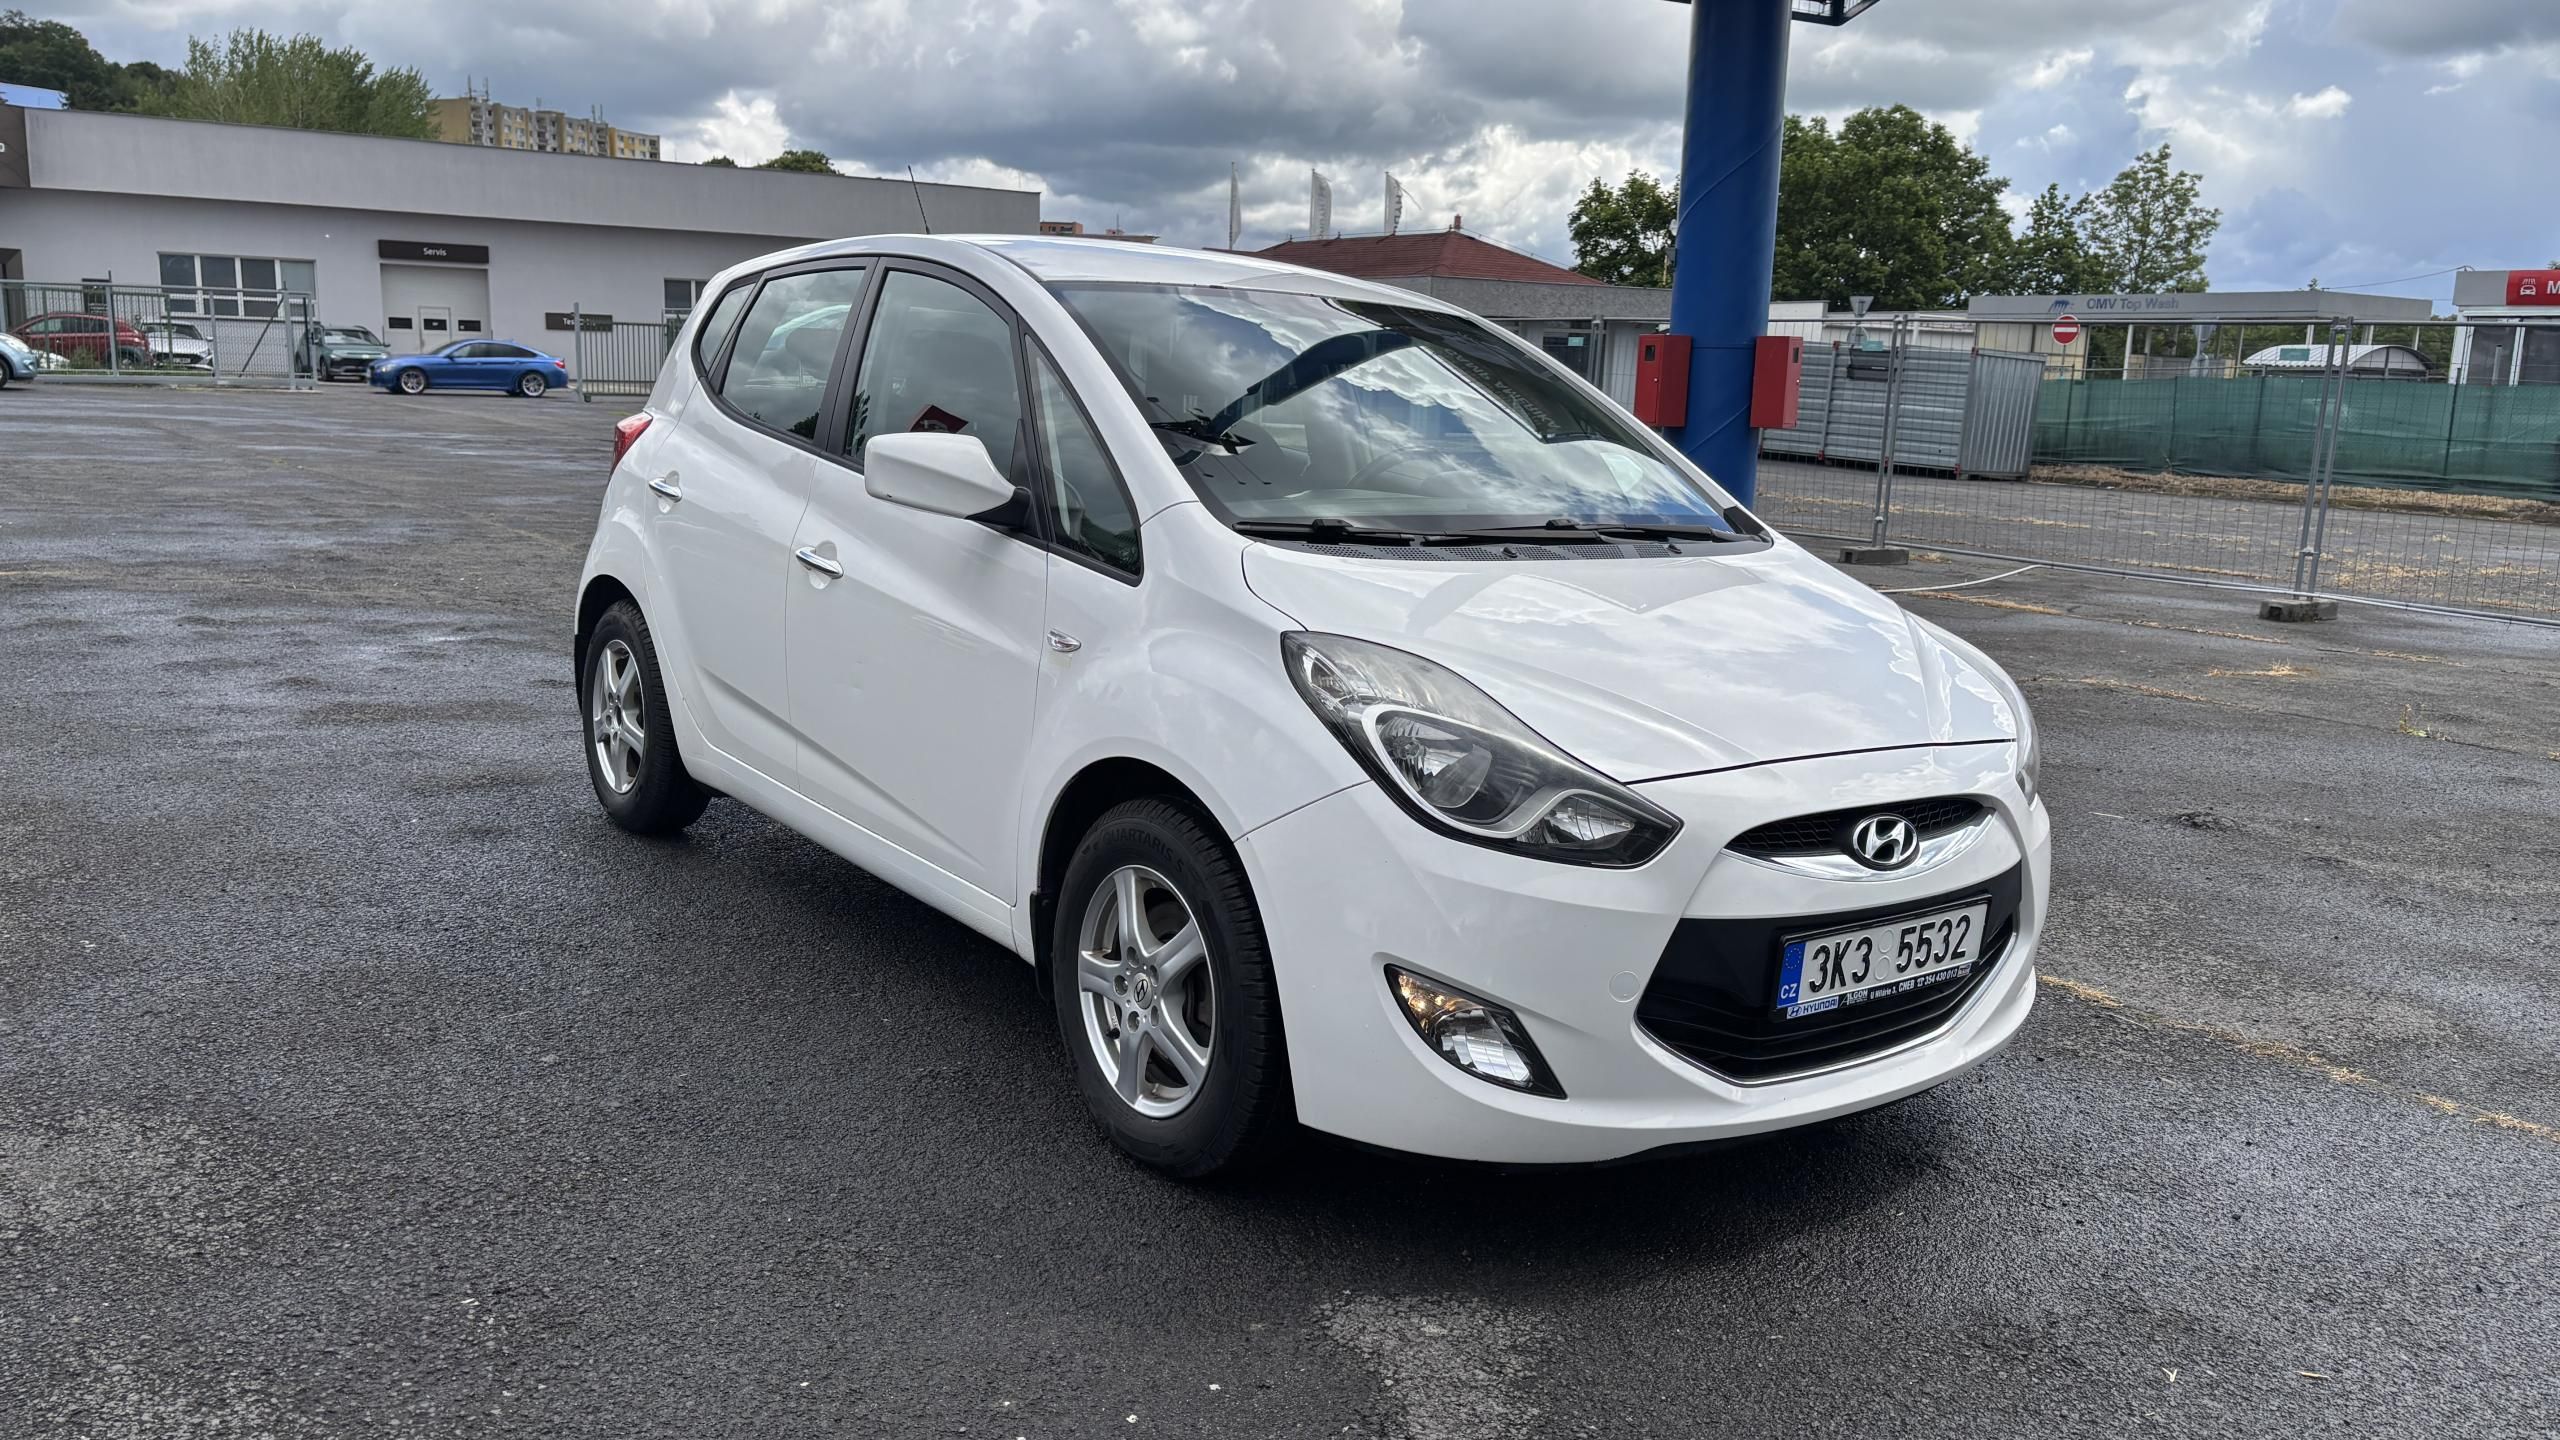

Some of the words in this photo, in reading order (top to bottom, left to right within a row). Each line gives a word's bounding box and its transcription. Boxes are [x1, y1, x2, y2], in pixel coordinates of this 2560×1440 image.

[423, 247, 447, 256] Servis
[2086, 298, 2118, 310] OMV
[2120, 298, 2140, 312] Top
[2145, 297, 2179, 310] Wash
[1102, 827, 1174, 861] QUARTARIS
[1809, 936, 1873, 993] 3K3
[1896, 914, 1971, 973] 5532
[1780, 983, 1798, 1000] CZ
[1841, 989, 1868, 1007] ALGON
[1803, 998, 1838, 1014] HYUNDAI
